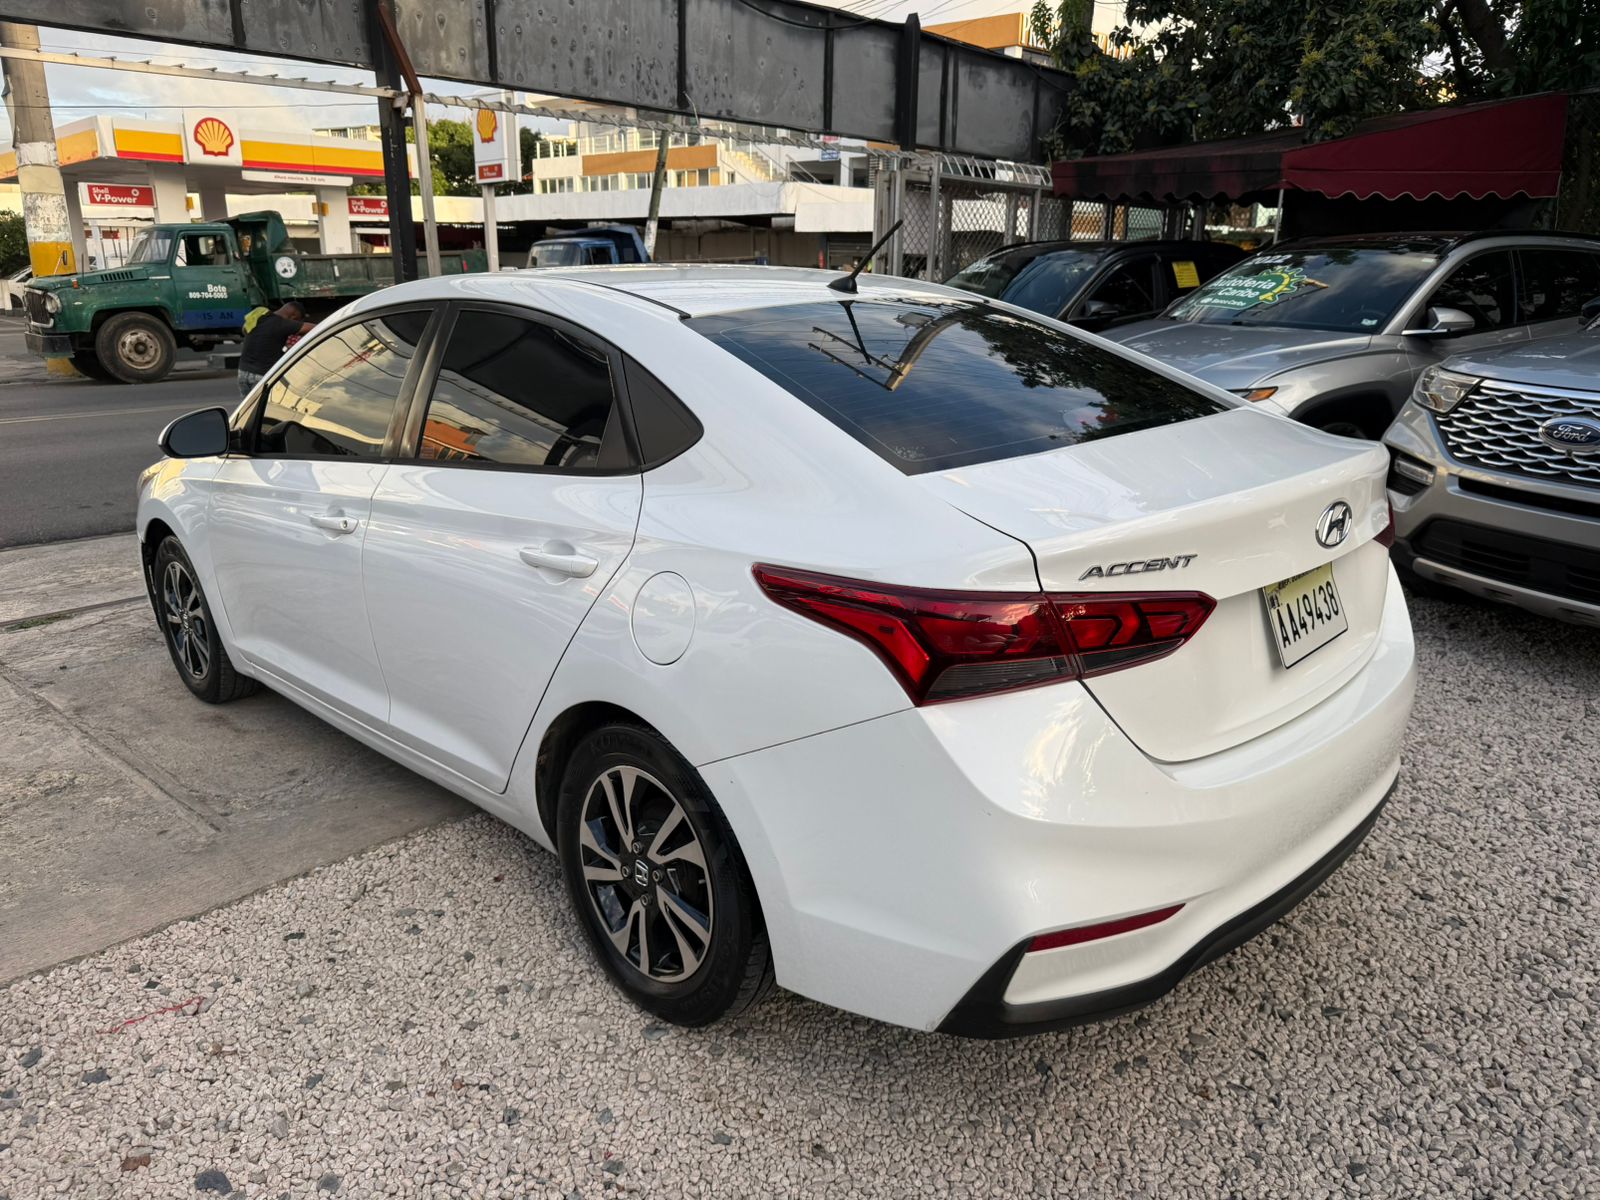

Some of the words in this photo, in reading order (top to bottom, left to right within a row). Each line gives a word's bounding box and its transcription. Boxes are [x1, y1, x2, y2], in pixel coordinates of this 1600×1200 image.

[93, 194, 138, 204] V-Power
[352, 206, 385, 214] V-Power
[207, 284, 227, 292] Bote
[1208, 278, 1276, 290] Autoferia
[1217, 287, 1260, 298] Caribe
[1552, 424, 1592, 442] Ford
[1078, 554, 1198, 581] ACCENT
[1276, 580, 1339, 649] AA49438
